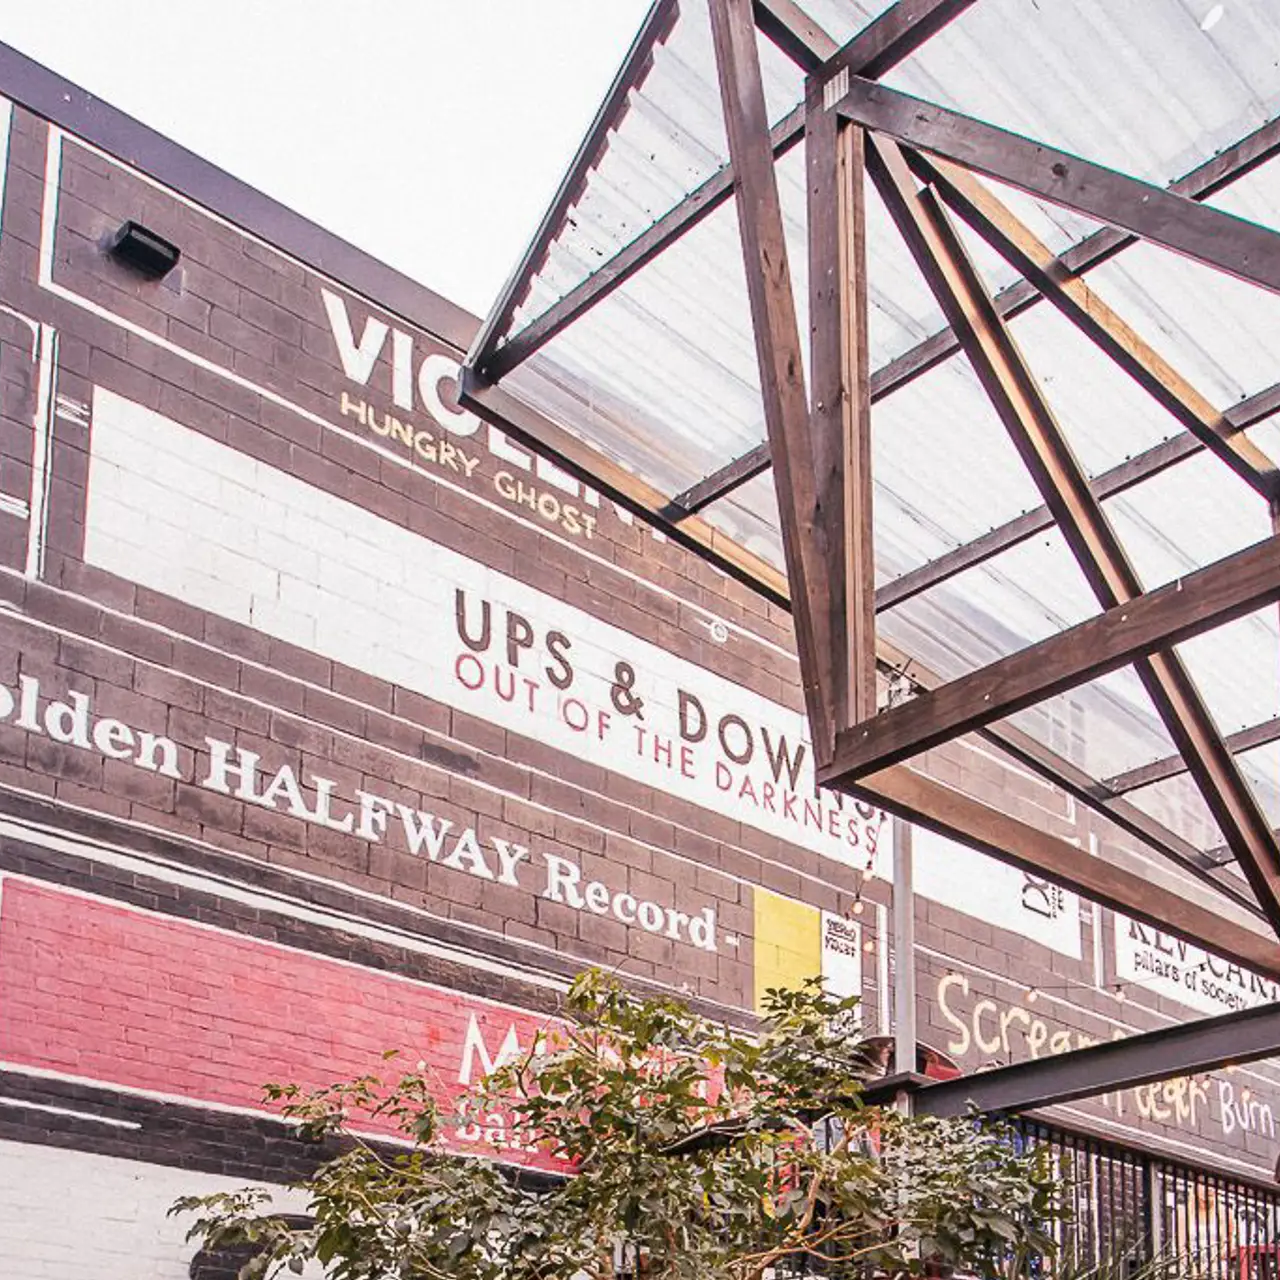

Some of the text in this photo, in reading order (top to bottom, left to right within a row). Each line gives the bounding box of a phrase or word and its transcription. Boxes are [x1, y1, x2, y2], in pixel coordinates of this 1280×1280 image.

[341, 392, 597, 540] HUNGRY GHOST
[455, 588, 875, 820] UPS & DOW
[455, 653, 877, 855] OUT OF THE DARKNESS
[202, 736, 532, 888] HALFWAY
[540, 852, 719, 951] Record
[1219, 1080, 1275, 1138] Burn
